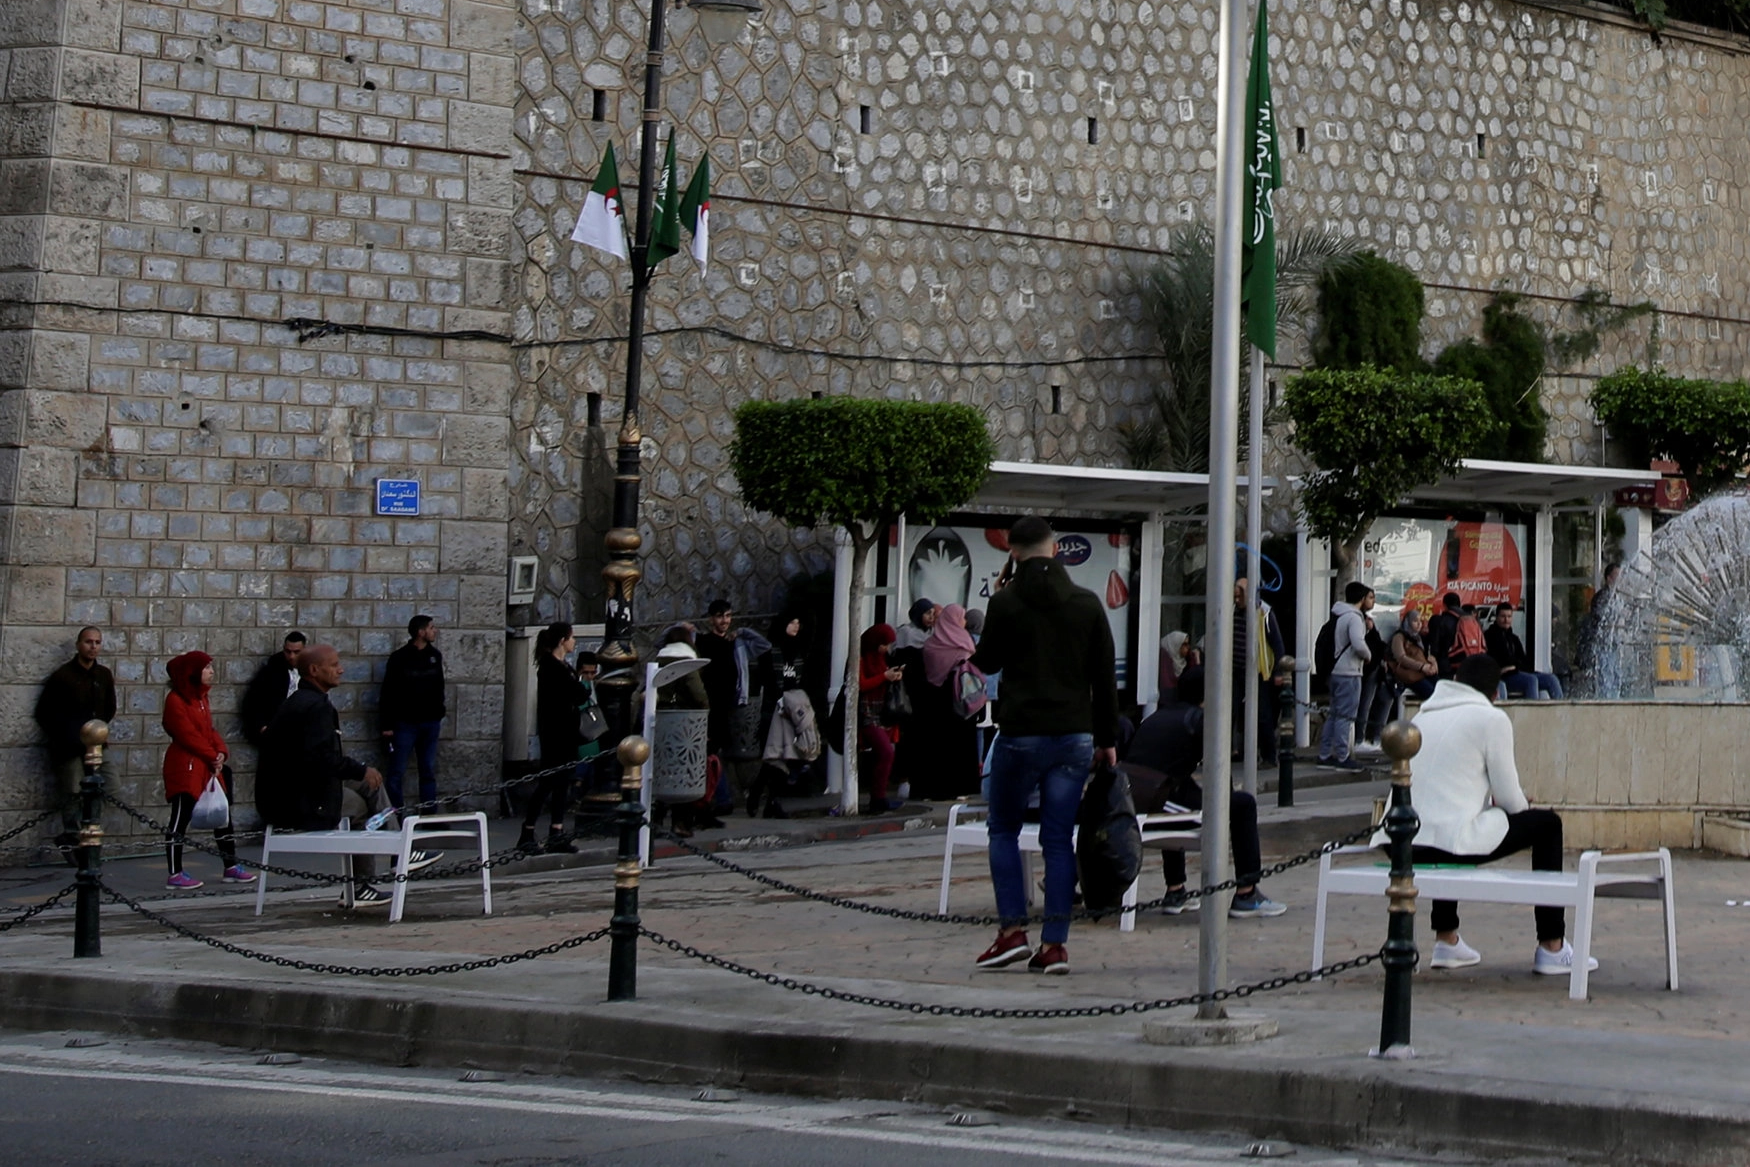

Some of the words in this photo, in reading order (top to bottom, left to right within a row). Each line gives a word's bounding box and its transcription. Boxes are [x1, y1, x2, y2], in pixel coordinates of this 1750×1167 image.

[1058, 541, 1087, 556] جديد
[1365, 537, 1397, 554] edoo
[1447, 581, 1459, 590] KIA
[1460, 581, 1492, 591] PICANTO
